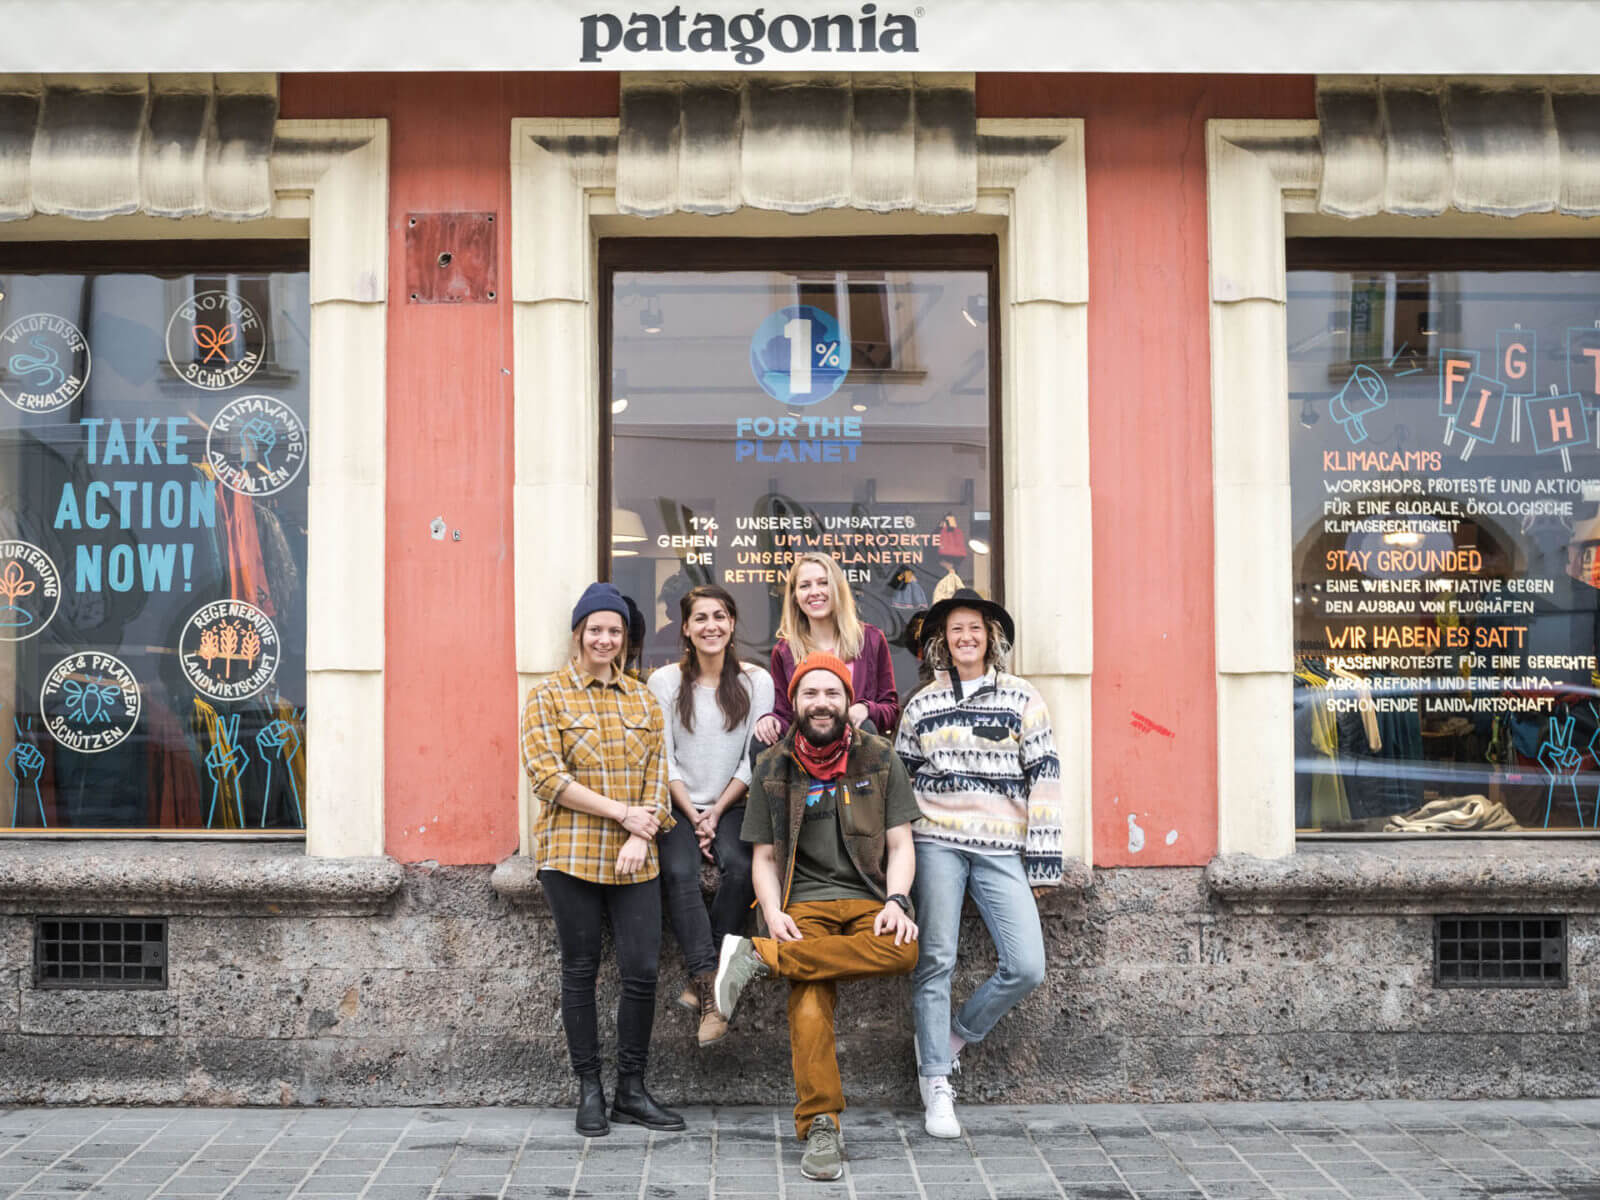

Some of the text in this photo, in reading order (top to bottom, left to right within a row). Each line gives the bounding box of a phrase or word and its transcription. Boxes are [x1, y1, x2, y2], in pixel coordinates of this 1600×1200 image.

[578, 3, 920, 65] patagonia
[179, 295, 258, 332] BIOTOPE
[186, 351, 257, 388] SCHÜTZEN
[16, 375, 81, 409] ERHALTEN
[215, 399, 302, 463] KLIMAWANDEL
[735, 415, 862, 438] FOR THE
[80, 416, 190, 465] TAKE
[735, 439, 862, 463] PLANET
[211, 450, 290, 493] AUFHALTEN
[1323, 450, 1442, 472] KLIMACAMPS
[1323, 478, 1426, 496] WORKSHOPS,
[1428, 478, 1496, 494] PROTESTE
[1501, 479, 1531, 494] UND
[54, 480, 216, 530] ACTION
[1324, 497, 1352, 516] FÜR
[1357, 501, 1391, 515] EINE
[1466, 498, 1574, 516] ÖKOLOGISCHE
[689, 516, 719, 530] 1%
[736, 516, 813, 530] UNSERES
[1324, 519, 1461, 533] KLIMAGERECHTIGKEIT
[656, 534, 718, 548] GEHEN
[730, 534, 757, 548] AN
[75, 543, 194, 593] NOW!
[686, 551, 713, 565] DIE
[831, 551, 923, 564] PLANETEN
[1325, 549, 1483, 572] STAY GROUNDED
[1325, 578, 1359, 593] EINE
[1361, 578, 1422, 593] WIENER
[1507, 579, 1555, 594] GEGEN
[1324, 600, 1353, 613] DEN
[1357, 600, 1416, 614] AUSBAU
[1449, 596, 1535, 614] FLUGHÄFEN
[193, 603, 276, 646] REGENERATIVE
[1325, 625, 1528, 649] WIR HABEN ES SATT
[1326, 651, 1597, 671] MASSENPROTESTE FÜR EINE GERECHTE
[92, 655, 137, 717] PFLANZEN
[183, 652, 275, 697] LANDWIRTSCHAFT
[1437, 676, 1465, 690] UND
[1468, 675, 1500, 690] EINE
[1326, 697, 1556, 713] SCHONENDE LANDWIRTSCHAFT
